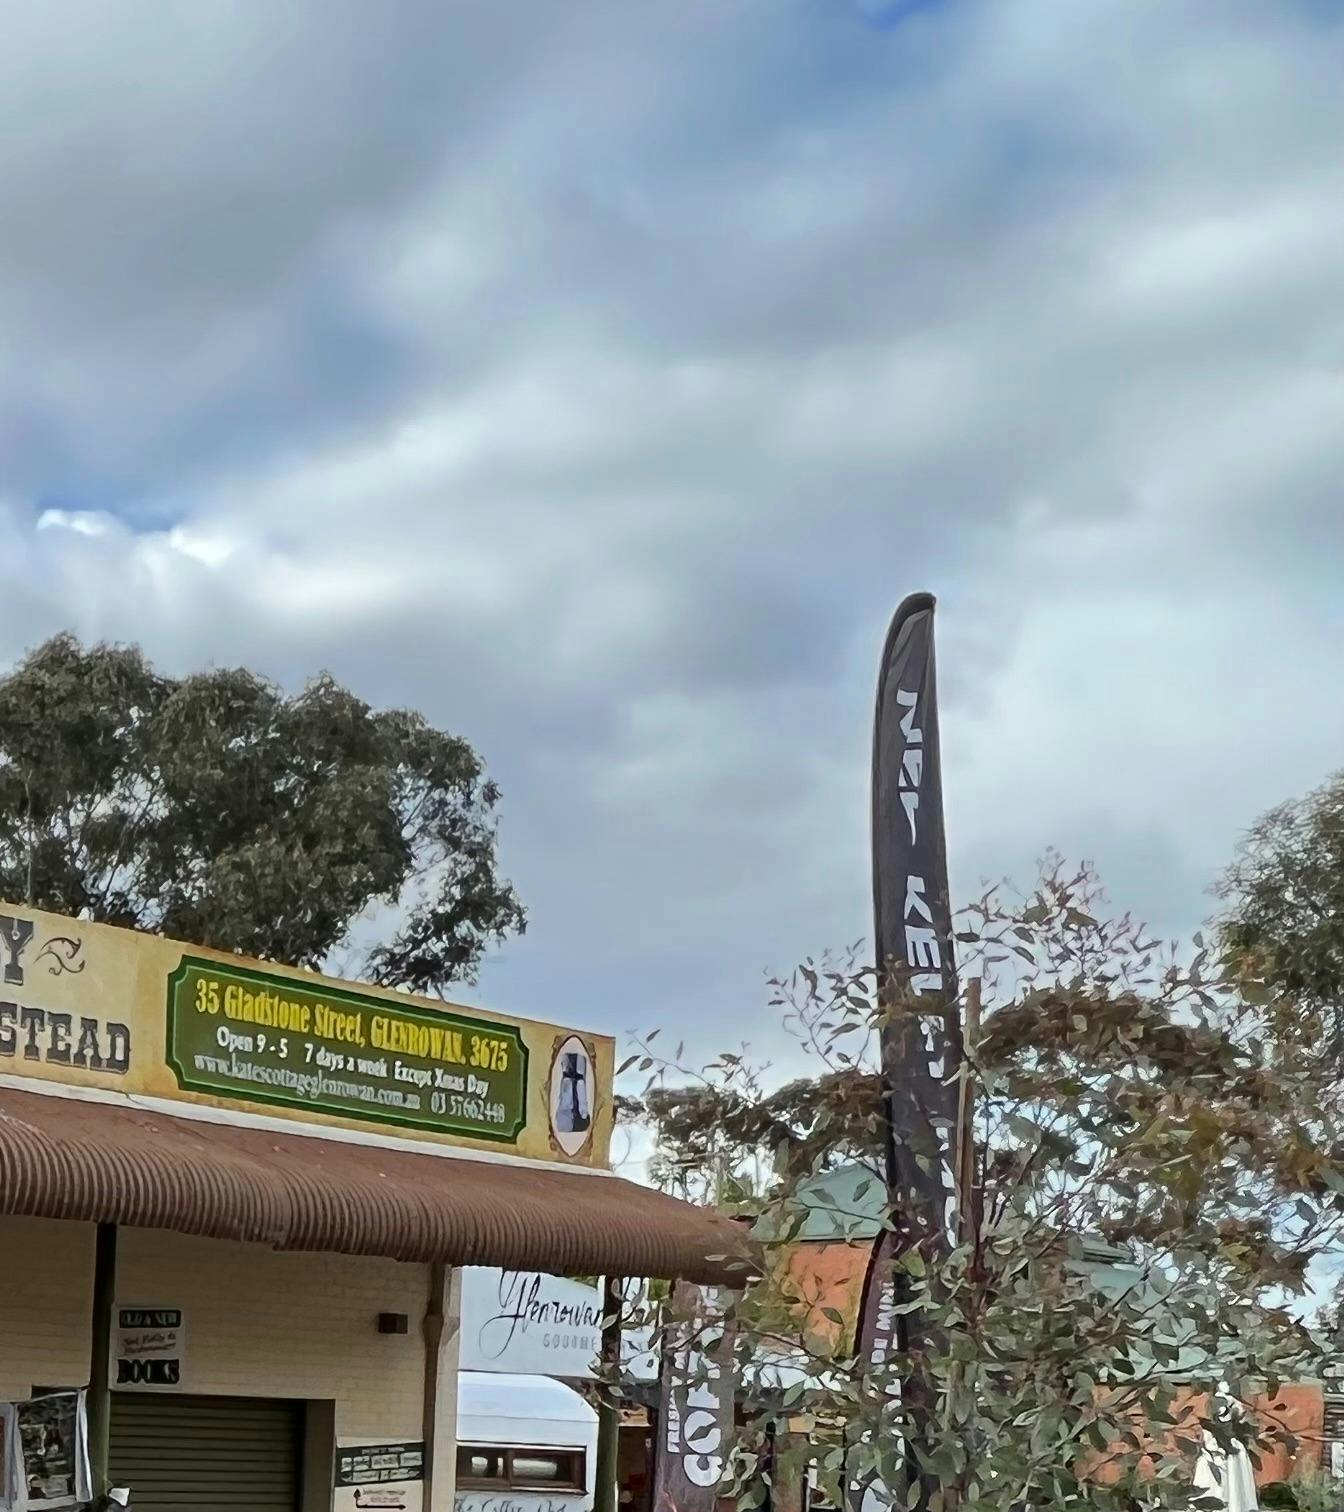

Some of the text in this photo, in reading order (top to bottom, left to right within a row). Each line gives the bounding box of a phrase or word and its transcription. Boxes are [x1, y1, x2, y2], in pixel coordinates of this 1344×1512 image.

[194, 978, 219, 1015] 35
[224, 985, 311, 1033] Gladstone
[314, 1005, 365, 1049] Street,
[469, 1037, 509, 1073] 3675
[216, 1026, 253, 1055] Open
[257, 1033, 266, 1053] 9
[279, 1038, 289, 1060] 5
[304, 1041, 313, 1064] 7
[316, 1045, 345, 1073] days
[347, 1056, 355, 1073] a
[394, 1061, 433, 1088] Except
[433, 1067, 466, 1093] Xmas
[468, 1072, 490, 1098] Day
[431, 1097, 447, 1116] 03
[683, 1290, 723, 1487] COFF
